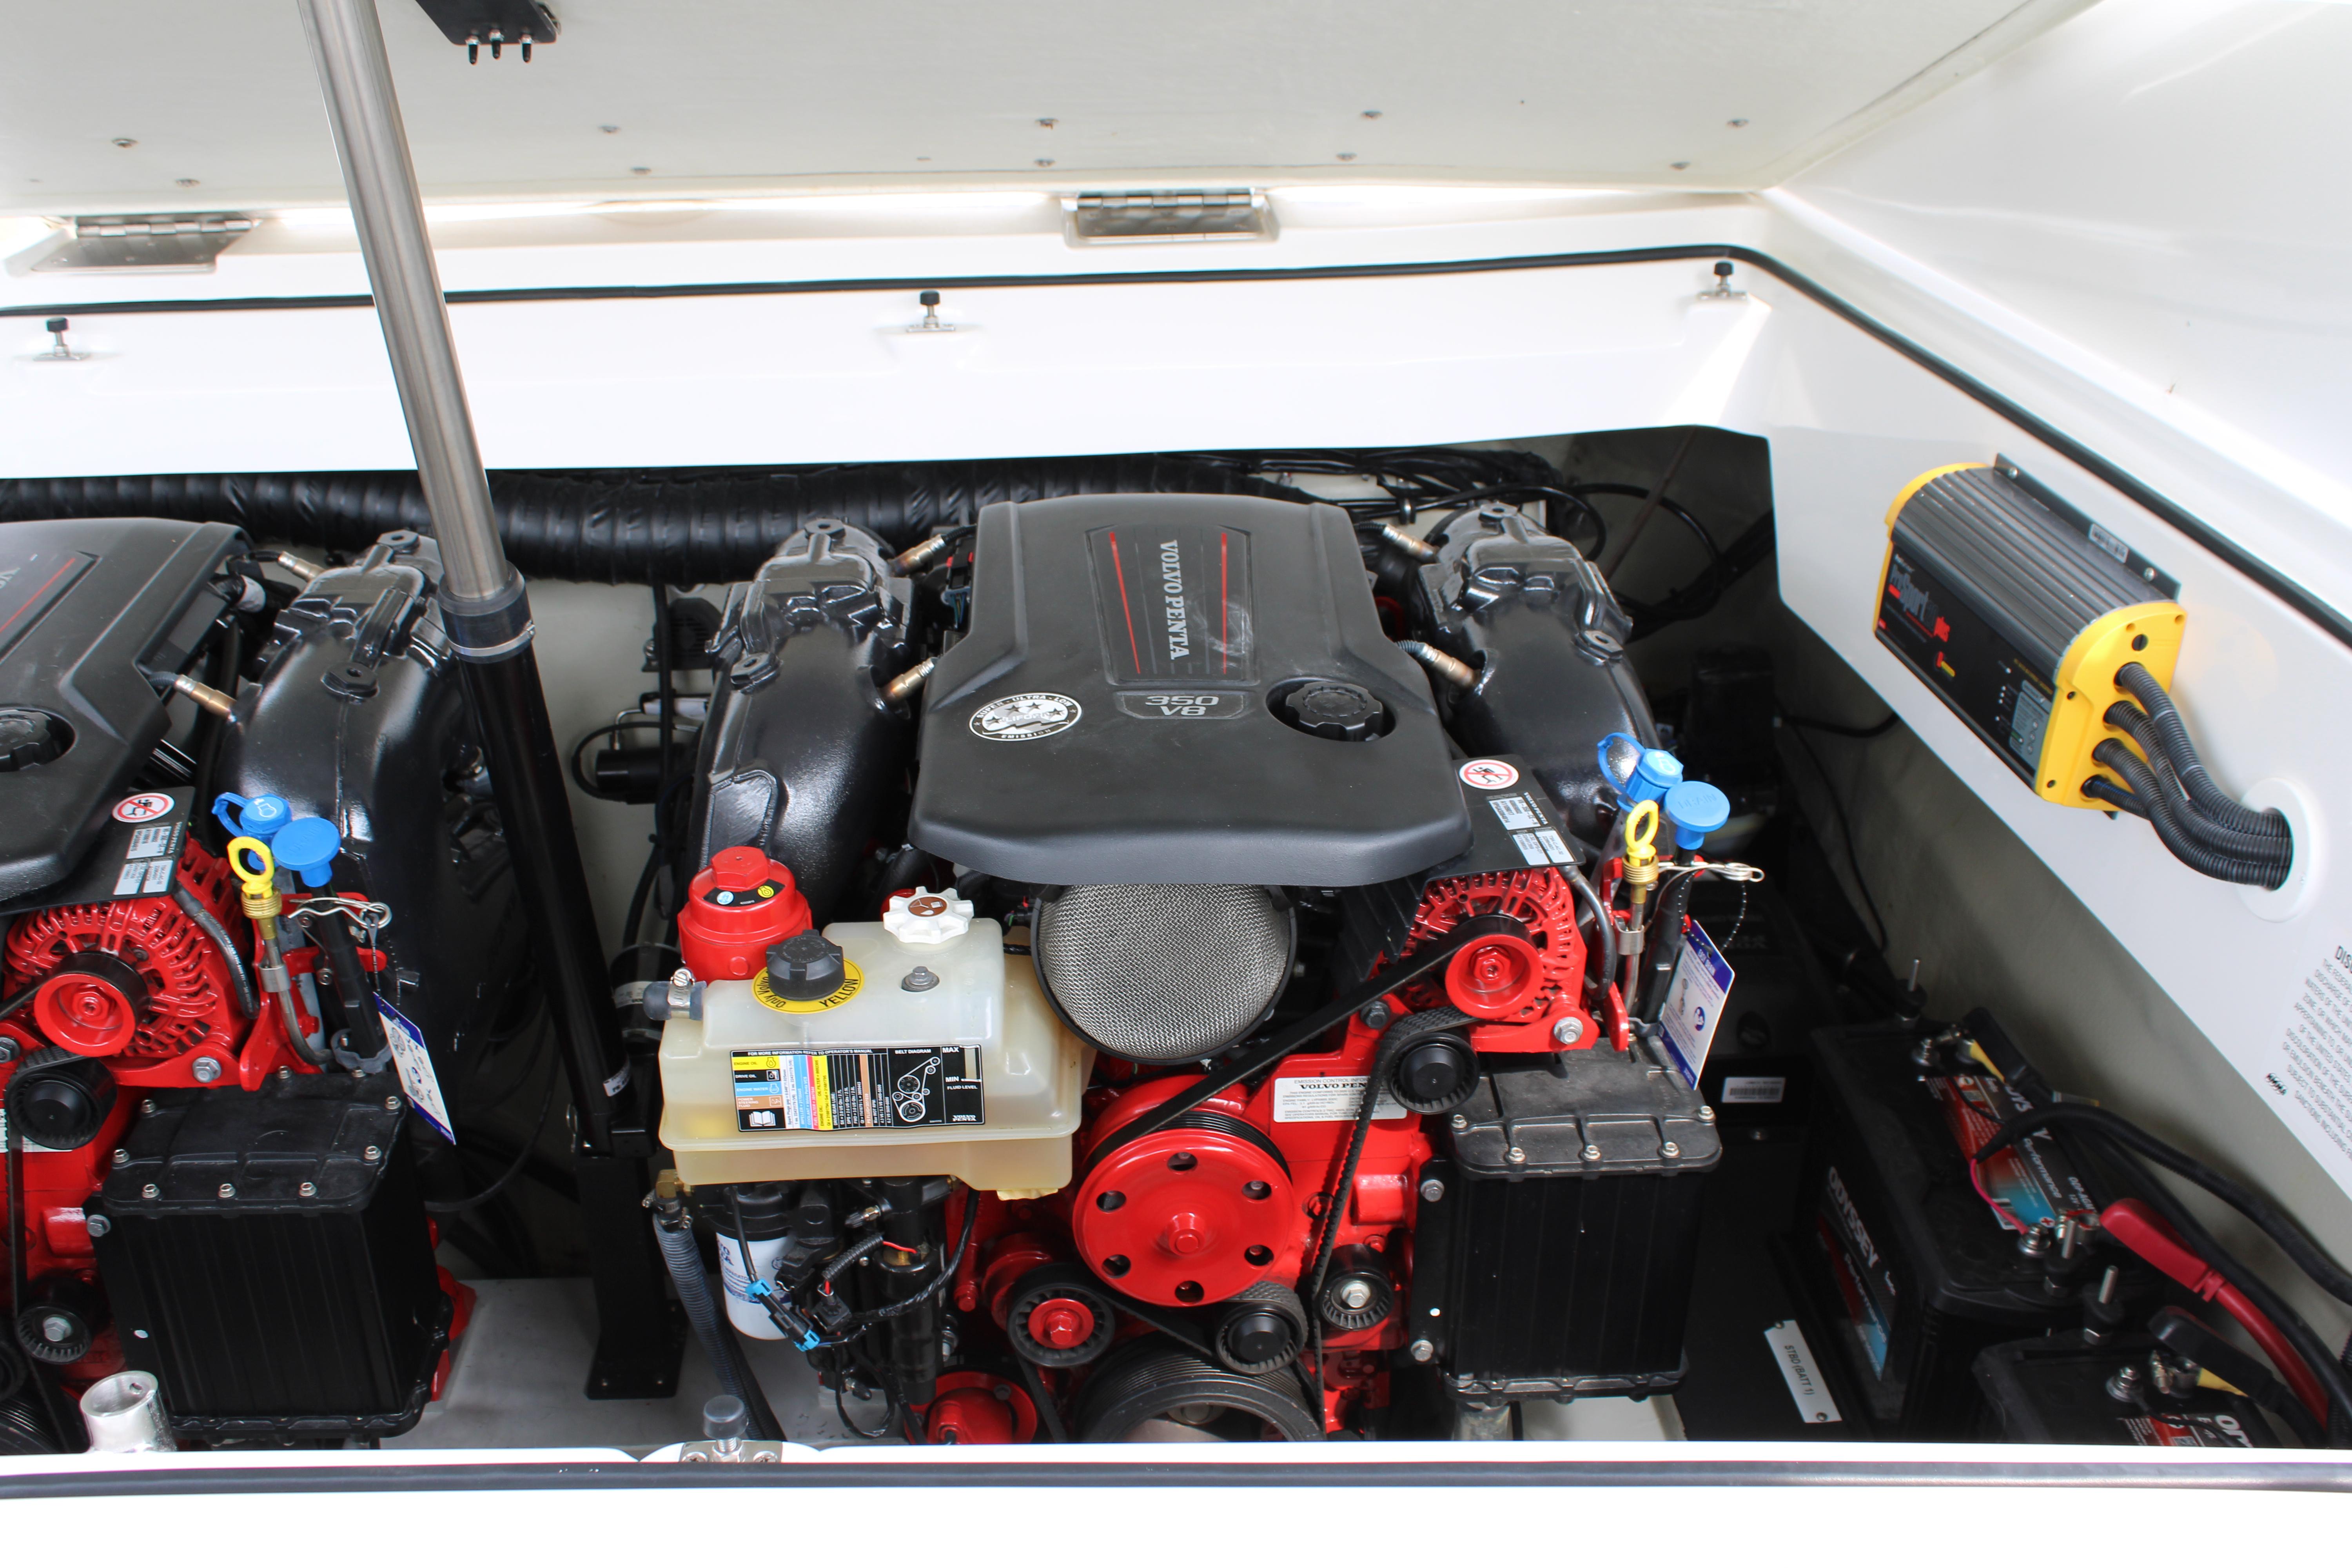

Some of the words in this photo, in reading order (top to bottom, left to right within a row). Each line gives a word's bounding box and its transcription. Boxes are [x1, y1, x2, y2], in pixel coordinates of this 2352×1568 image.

[1160, 540, 1183, 593] VOLVO
[1165, 596, 1189, 659] PENTA
[976, 701, 1004, 719] SUPER
[1054, 697, 1073, 706] LOW
[1145, 696, 1219, 706] 350
[1160, 706, 1207, 715] V8
[1001, 729, 1051, 738] EMISSION
[764, 994, 786, 1008] Only
[820, 978, 859, 1007] YELLOW
[2024, 1137, 2062, 1198] Performance
[1828, 1165, 1882, 1269] ODYSSEY
[1844, 1252, 1887, 1345] Performance
[1784, 1345, 1801, 1364] STBD
[1792, 1365, 1811, 1386] (BATT
